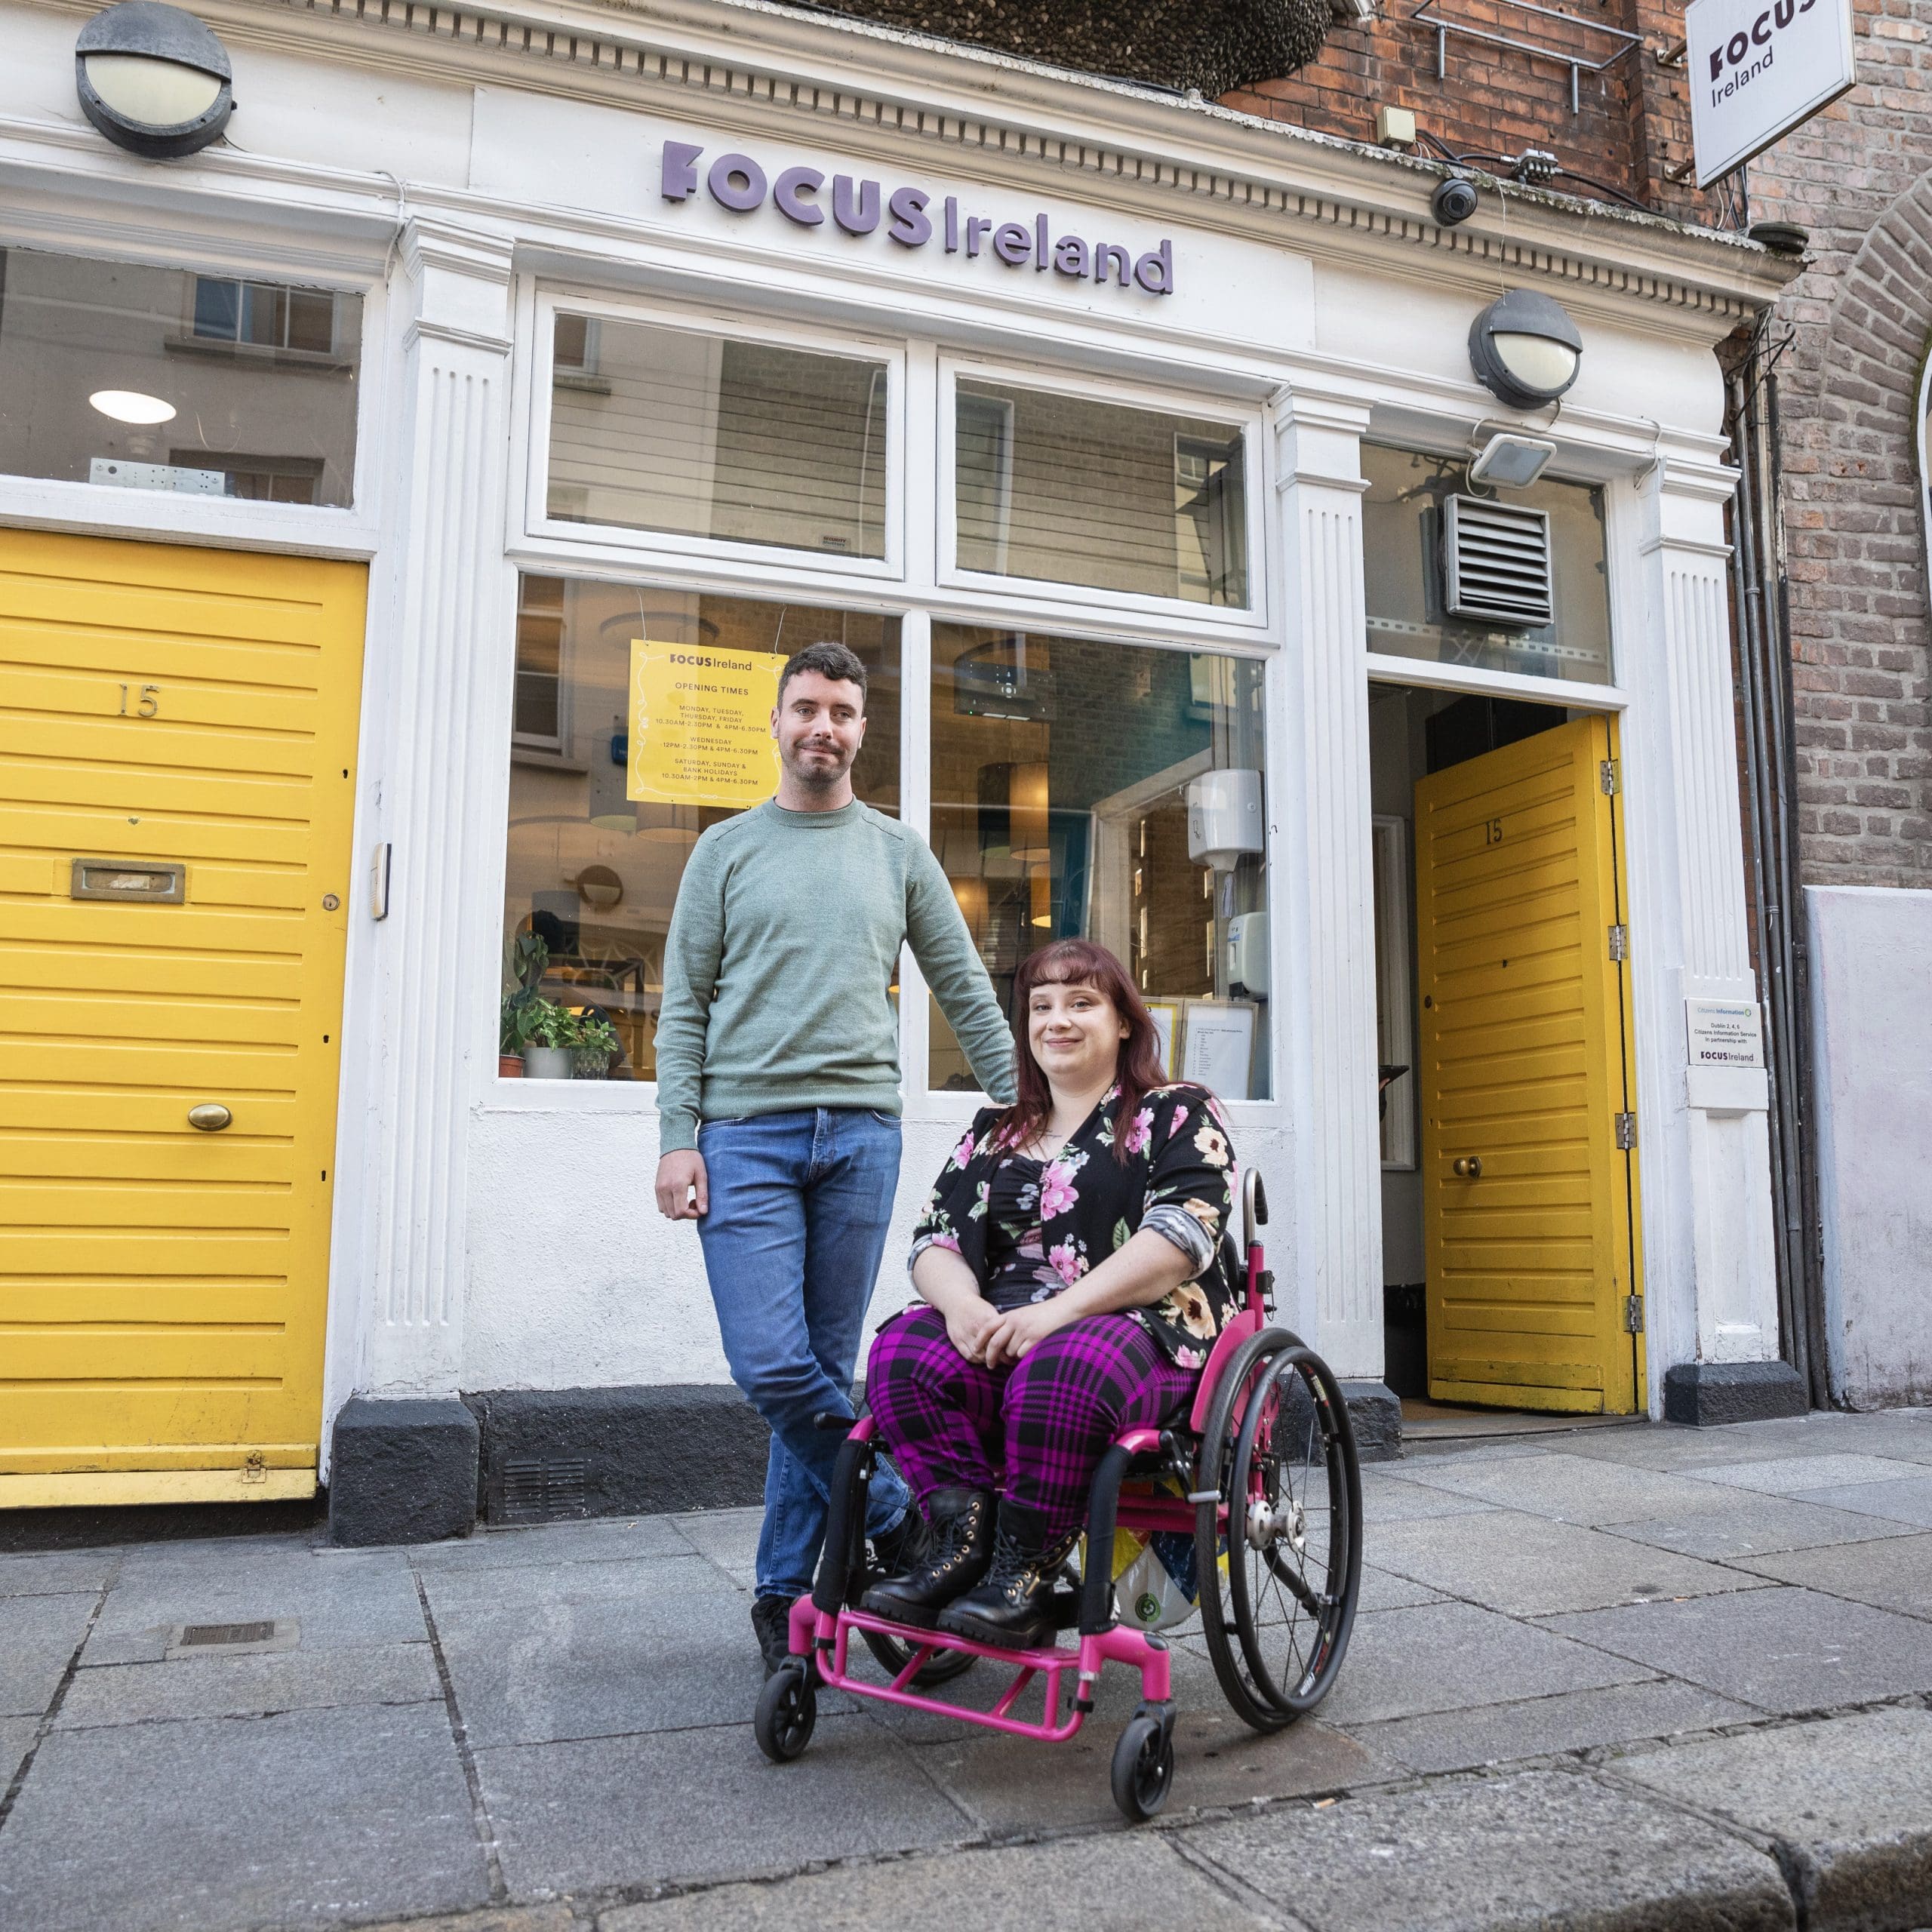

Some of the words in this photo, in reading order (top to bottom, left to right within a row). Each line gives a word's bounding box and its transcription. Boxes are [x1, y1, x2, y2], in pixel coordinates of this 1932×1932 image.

[1712, 45, 1773, 107] Ireland
[945, 196, 1174, 295] Ireland
[713, 658, 752, 671] Ireland
[675, 682, 718, 692] OPENING
[721, 686, 749, 695] TIMES
[120, 682, 158, 717] 15
[681, 712, 717, 721] THURSDAY,
[713, 708, 744, 716] TUESDAY,
[724, 724, 766, 733] 4PM-6.30PM
[691, 737, 732, 745] WEDNESDAY
[716, 747, 758, 755] 4PM-6.30PM
[675, 758, 711, 767] SATURDAY,
[1486, 817, 1503, 845] 15
[1716, 1008, 1745, 1016] Information
[1728, 1052, 1755, 1062] Ireland
